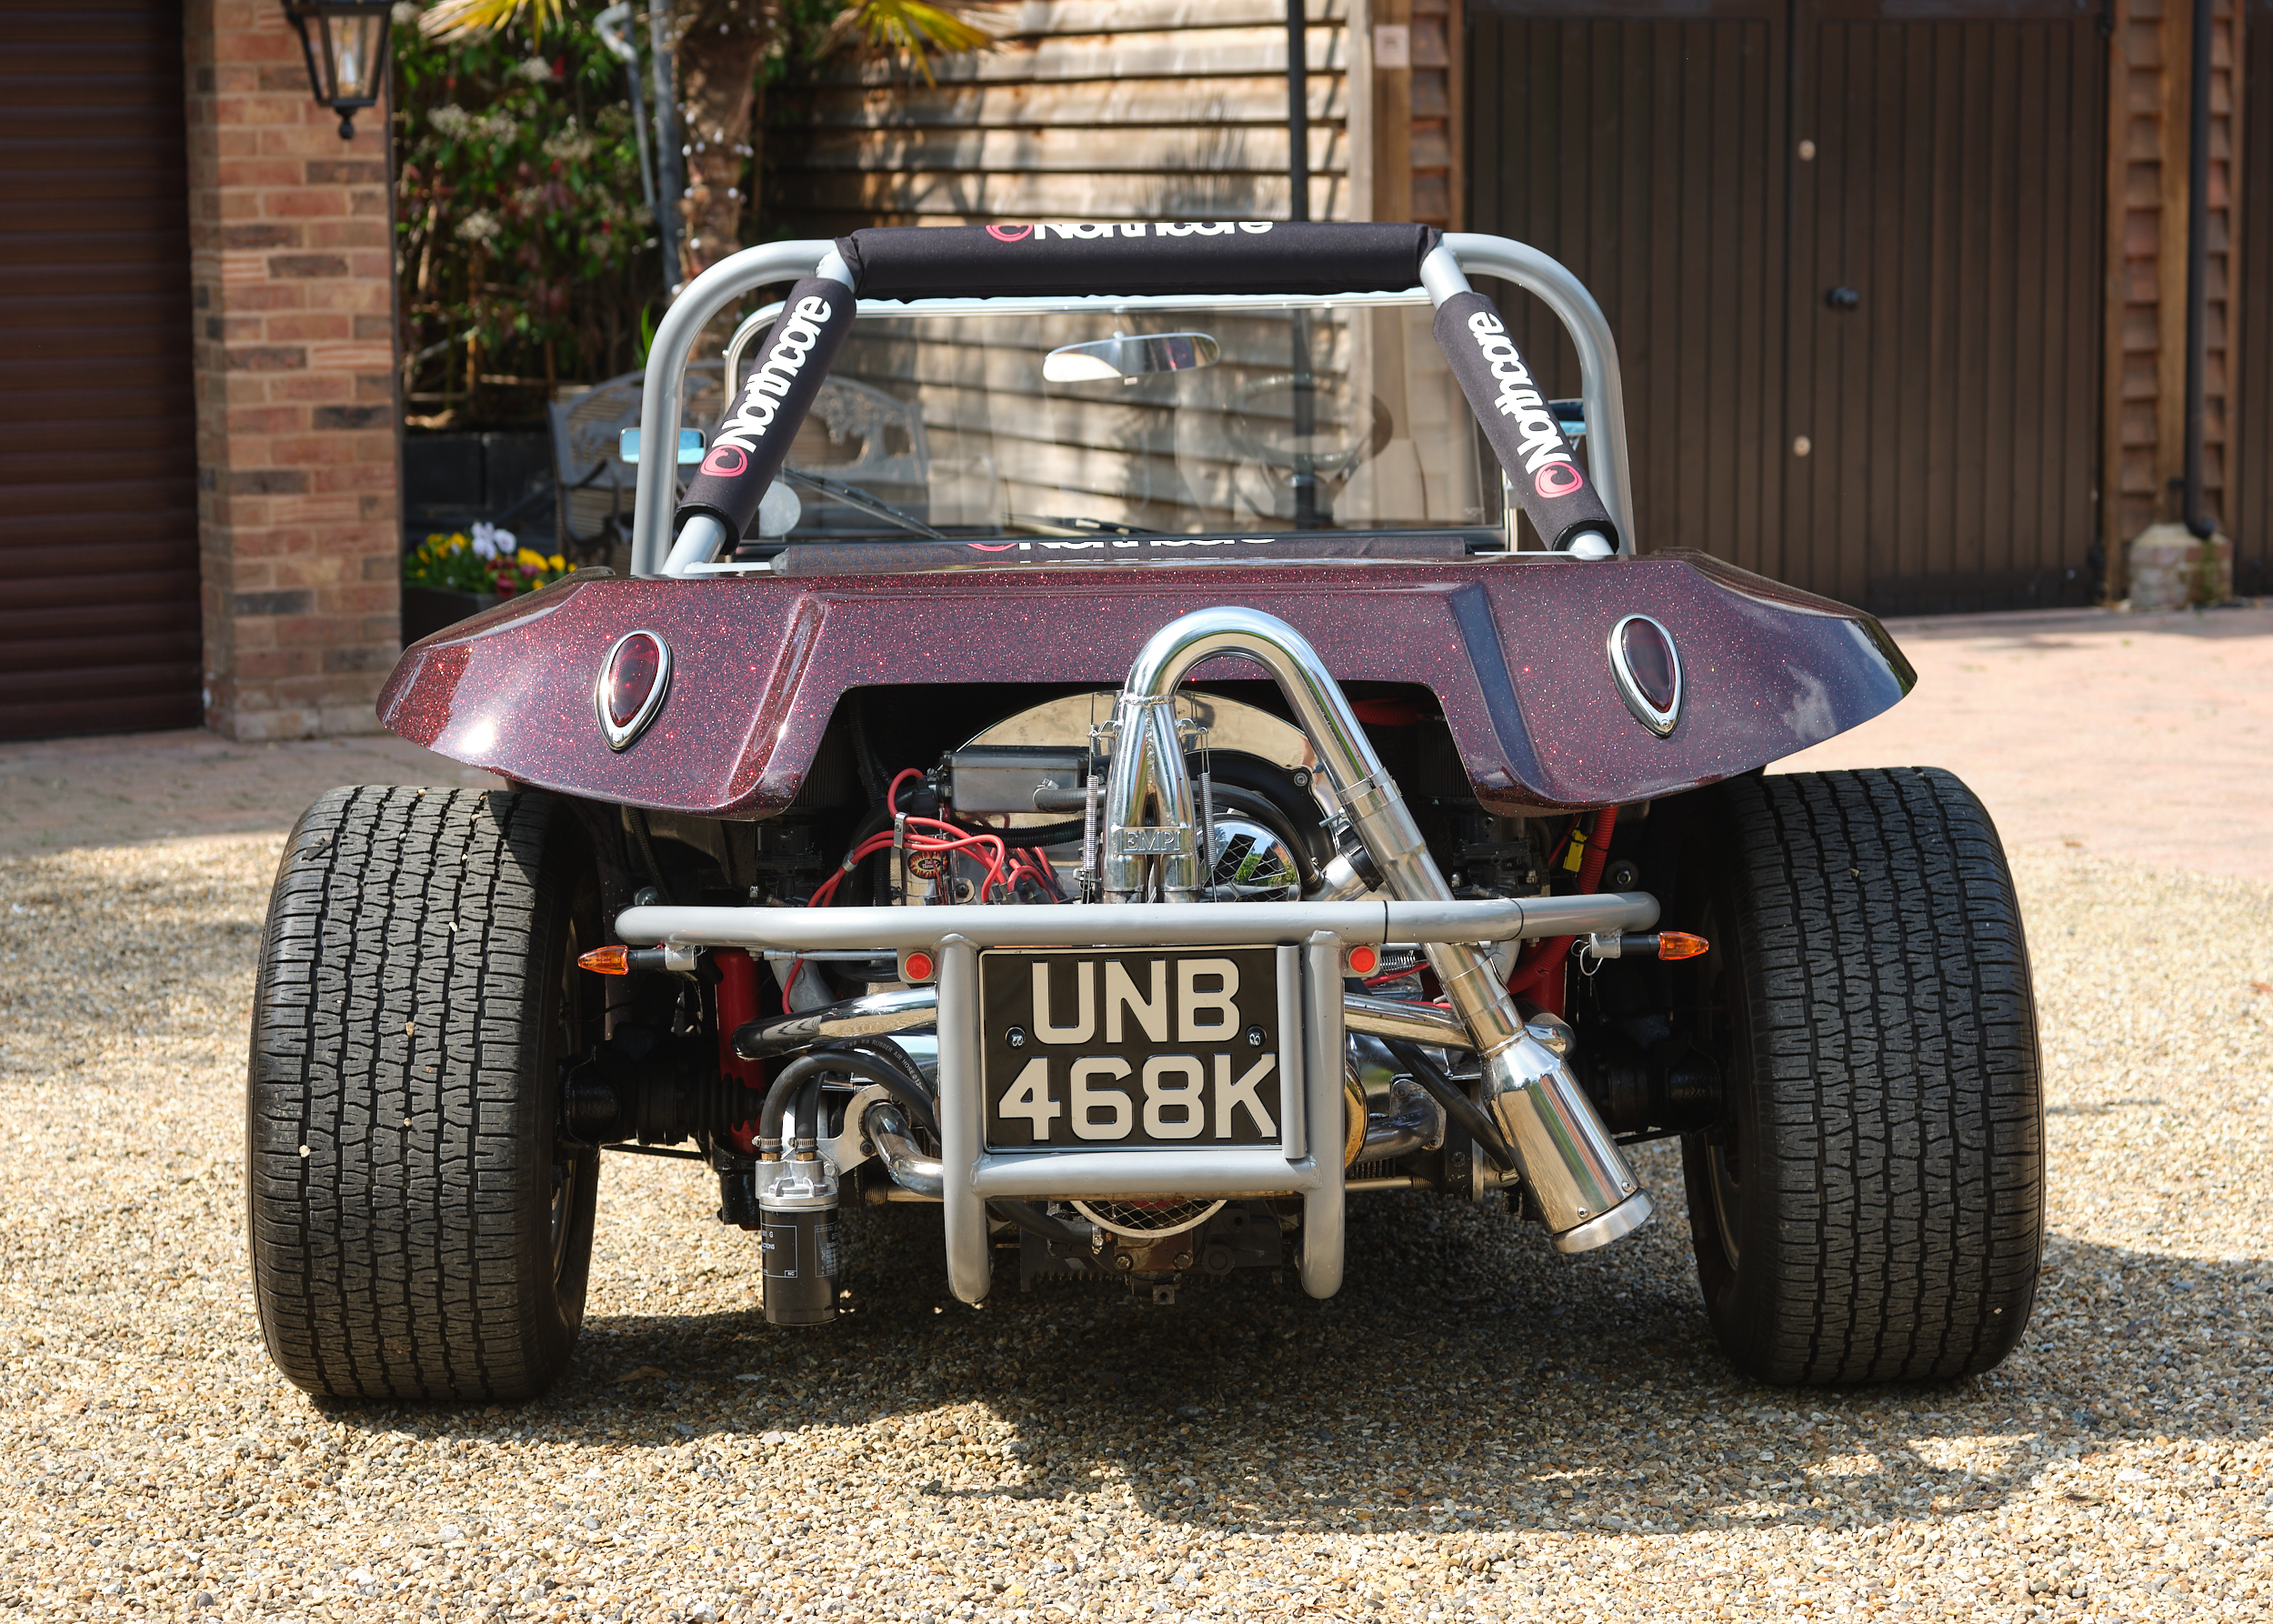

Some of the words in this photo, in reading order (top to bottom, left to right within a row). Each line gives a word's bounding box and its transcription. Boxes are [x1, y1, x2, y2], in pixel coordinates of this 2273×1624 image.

[711, 296, 832, 453] Northcore
[1467, 311, 1572, 475] Northcore
[1124, 831, 1181, 851] EMPI
[1031, 957, 1240, 1045] UNB
[871, 1038, 894, 1053] RUBBER
[893, 1050, 903, 1060] AIR
[901, 1058, 915, 1076] HOSE
[998, 1052, 1278, 1141] 468K
